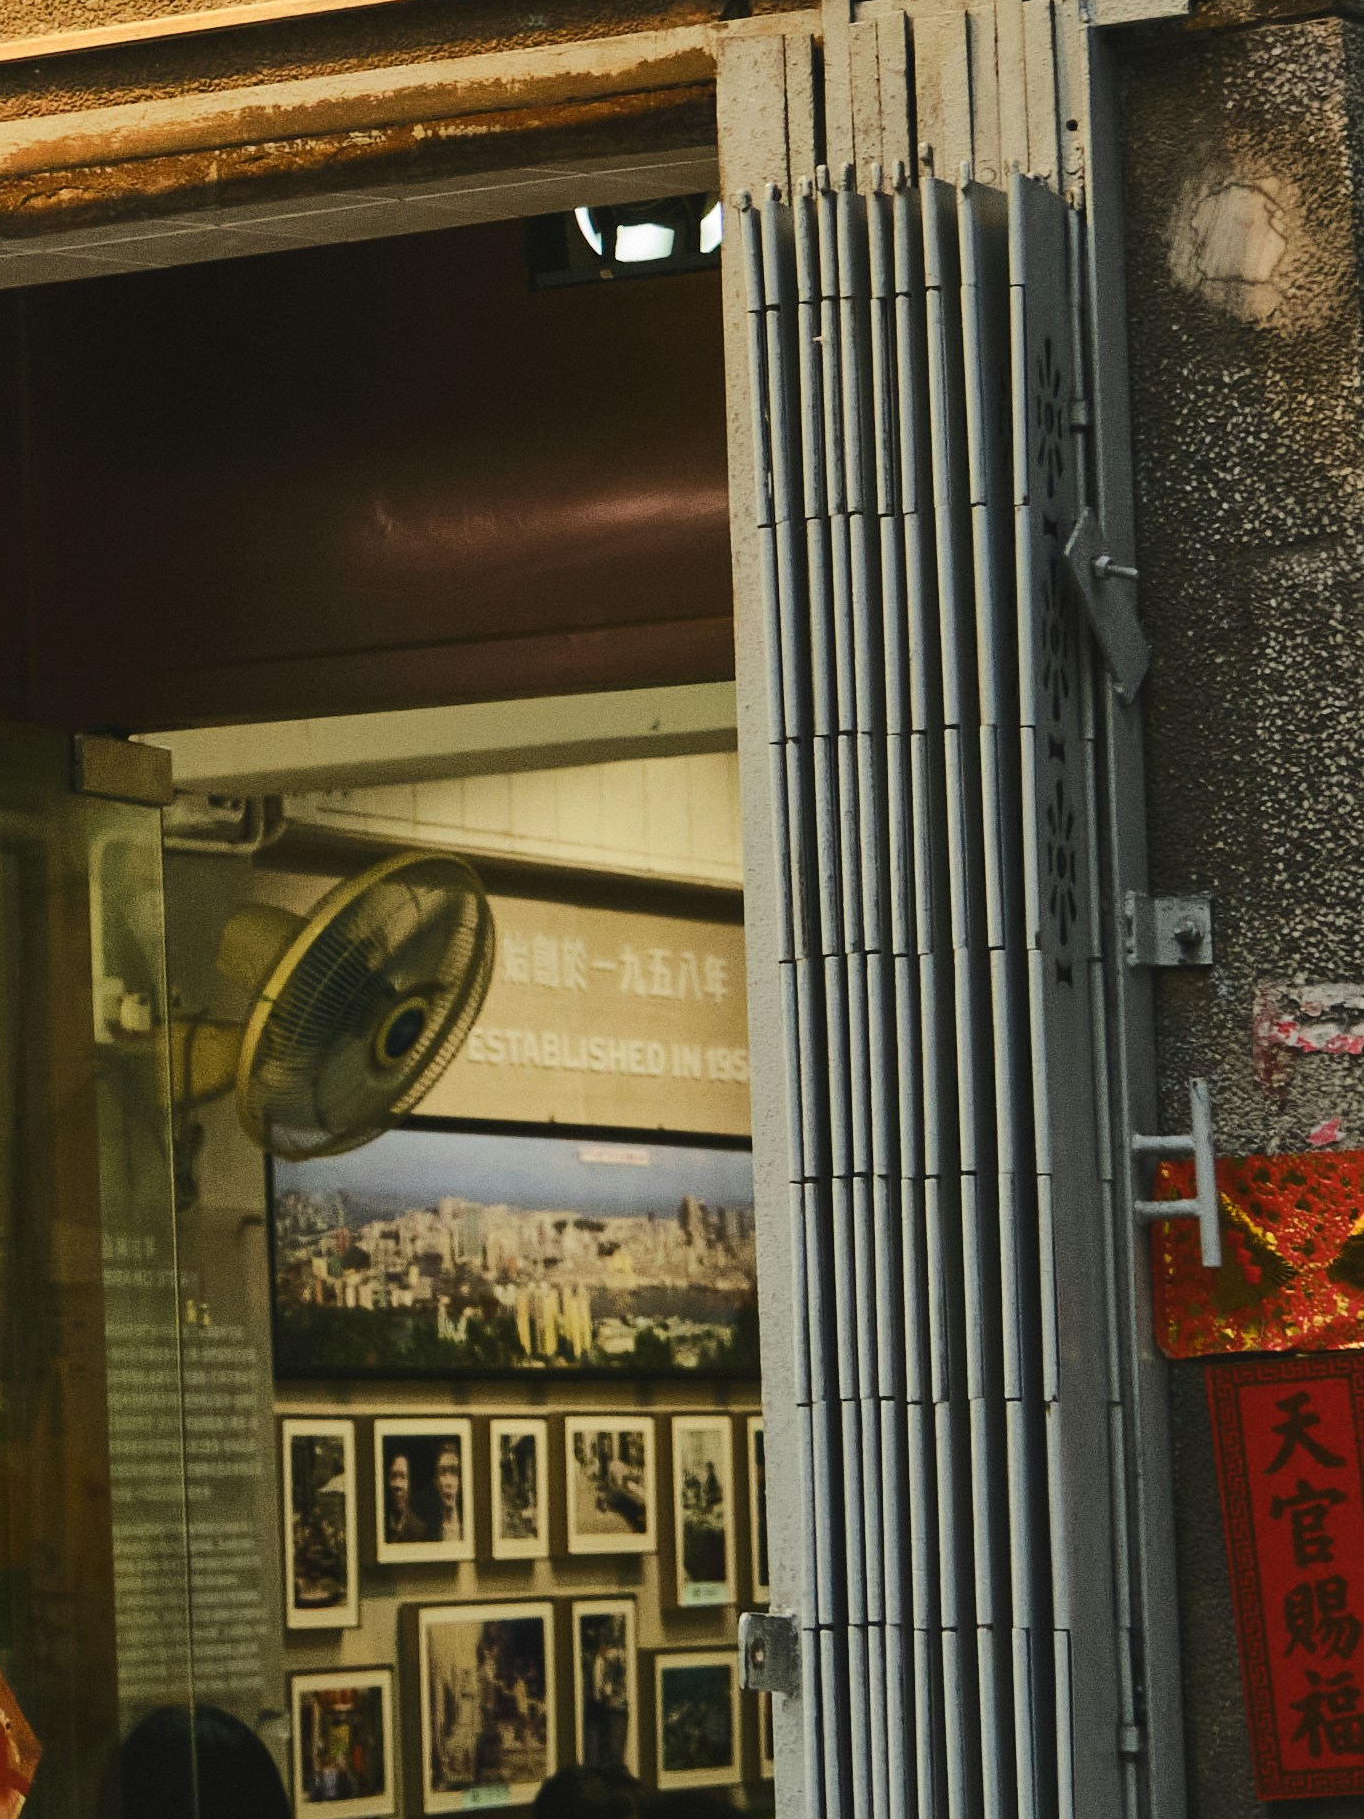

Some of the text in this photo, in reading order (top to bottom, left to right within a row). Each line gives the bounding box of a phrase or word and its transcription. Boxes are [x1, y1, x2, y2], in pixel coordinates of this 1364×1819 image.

[468, 1028, 749, 1083] ESTABLISHED IN 195
[1263, 1390, 1364, 1759] 天官賜福
